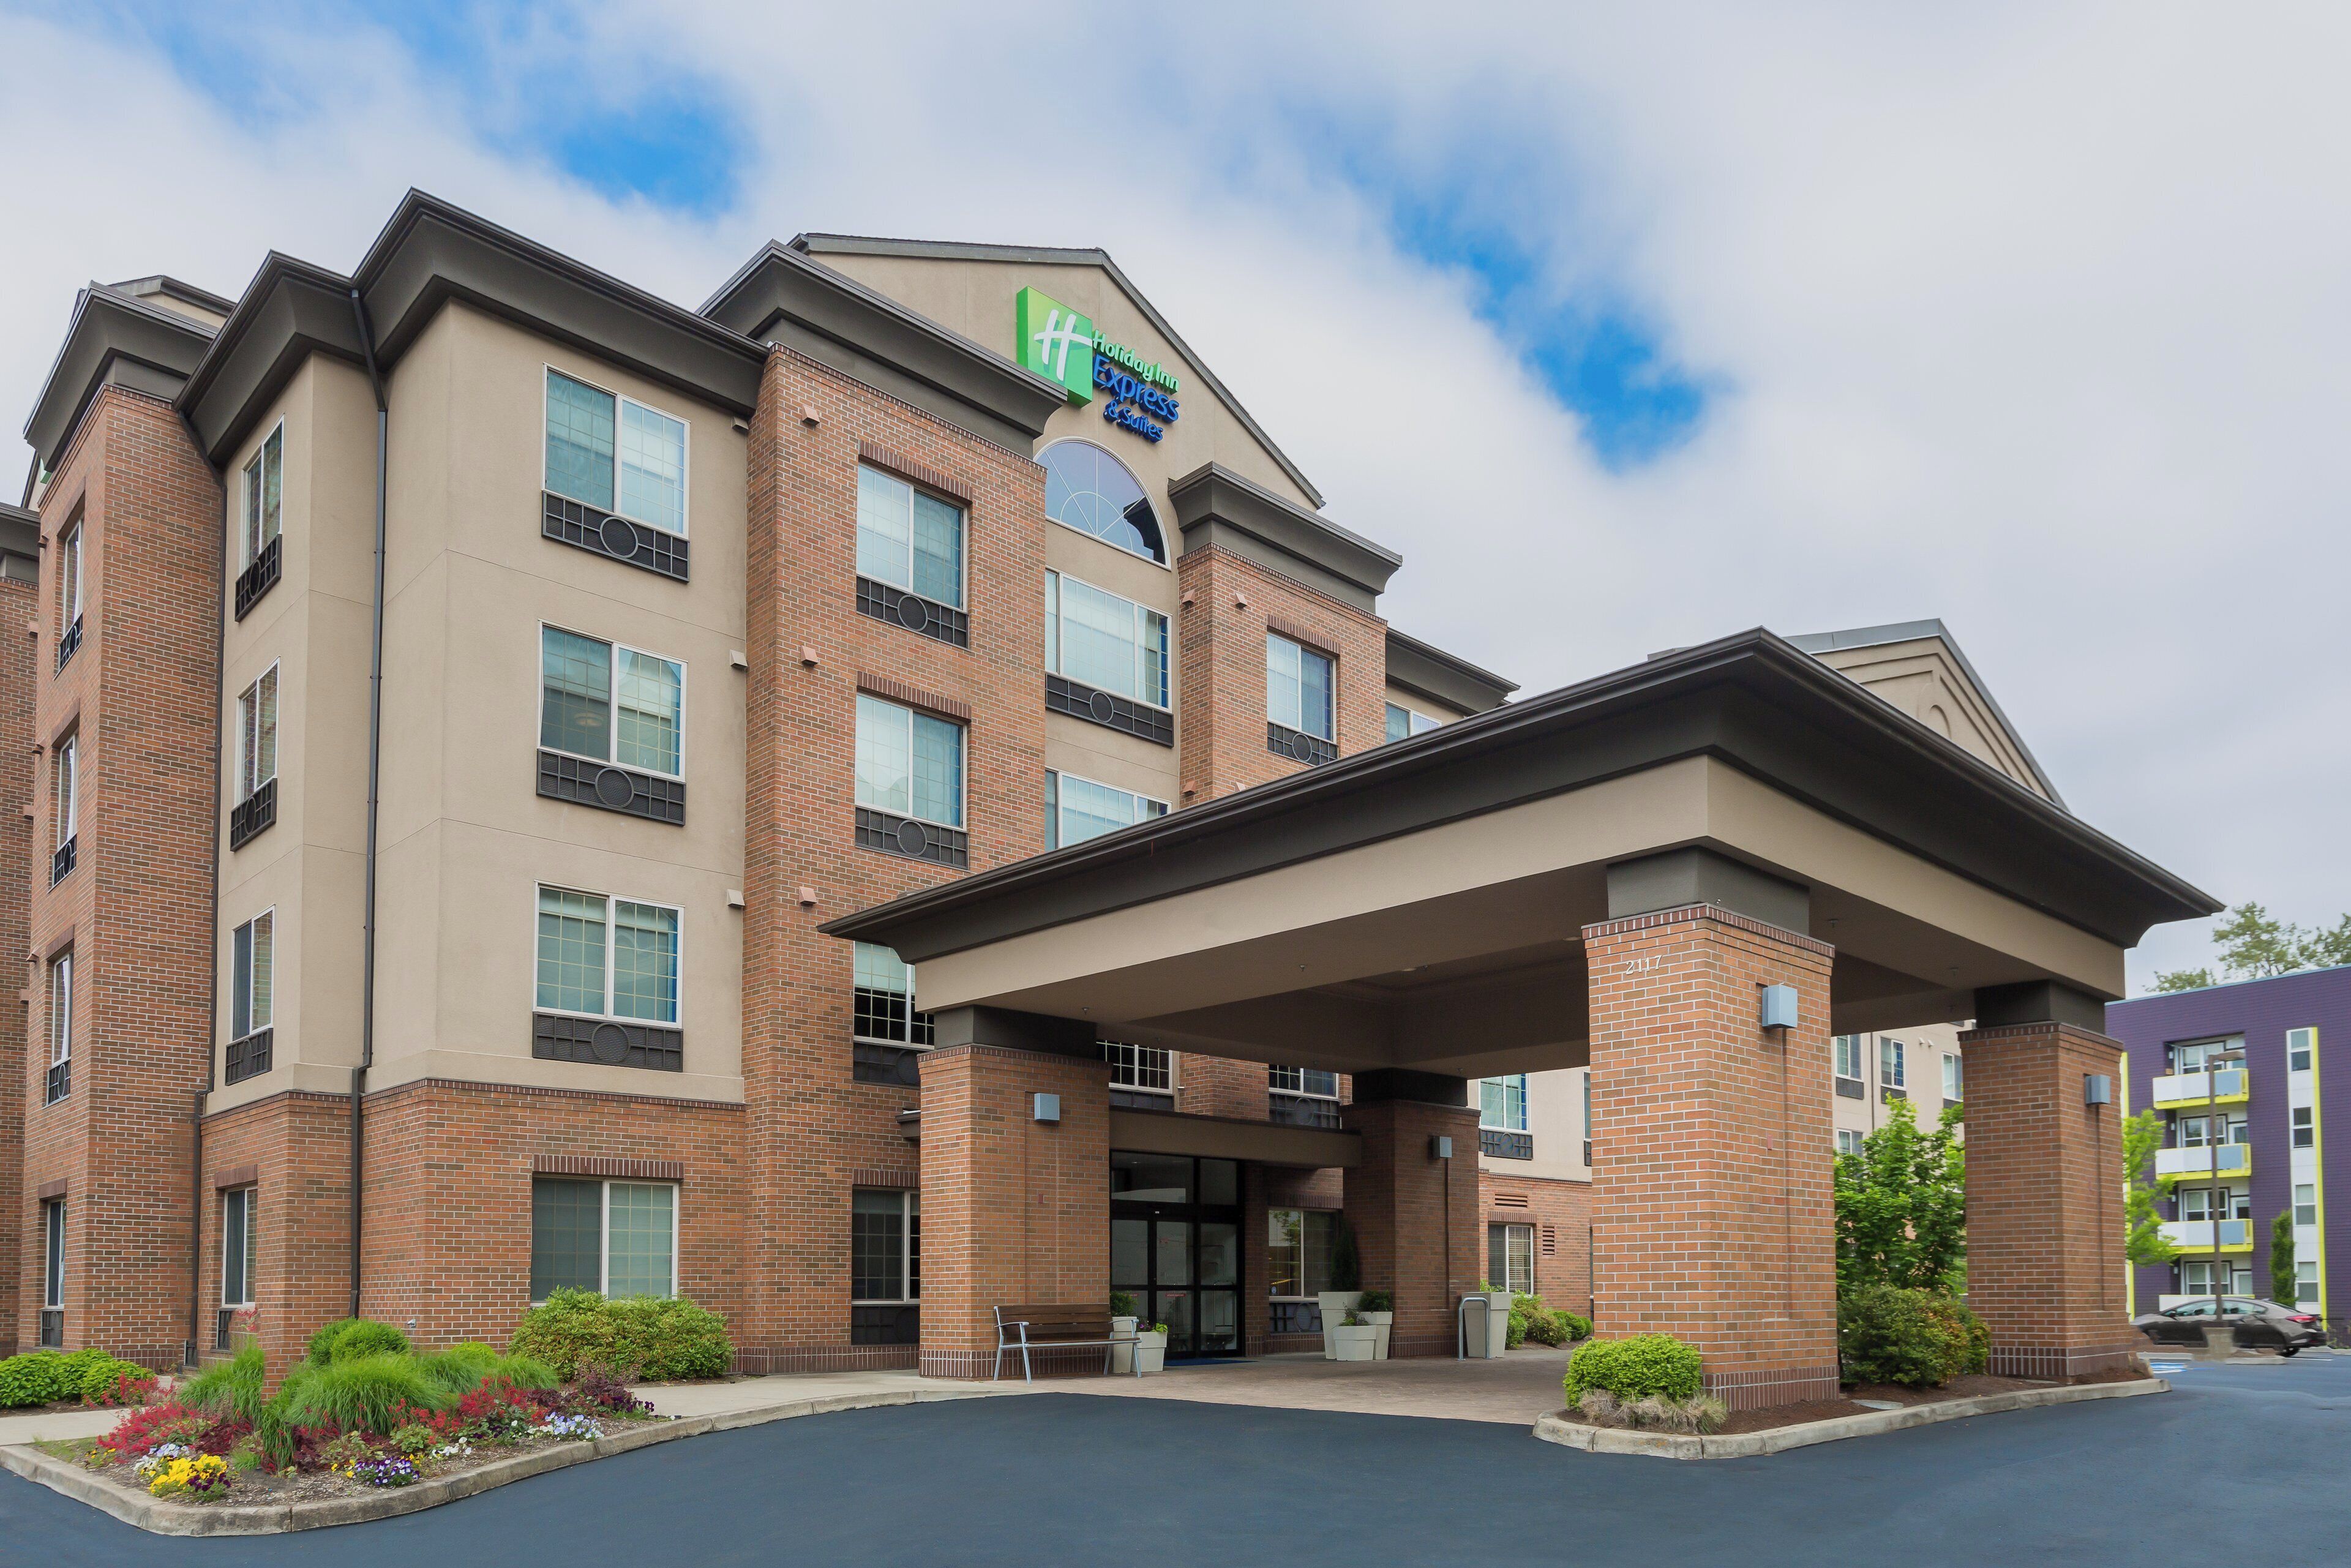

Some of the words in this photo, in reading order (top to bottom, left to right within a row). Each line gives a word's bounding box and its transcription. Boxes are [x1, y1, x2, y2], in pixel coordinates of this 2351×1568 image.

[1092, 329, 1153, 381] Holiday
[1155, 361, 1180, 392] Inn
[1092, 353, 1180, 422] Express
[1105, 400, 1119, 419] &
[1120, 407, 1163, 441] Suites
[1625, 955, 1662, 975] 2117
